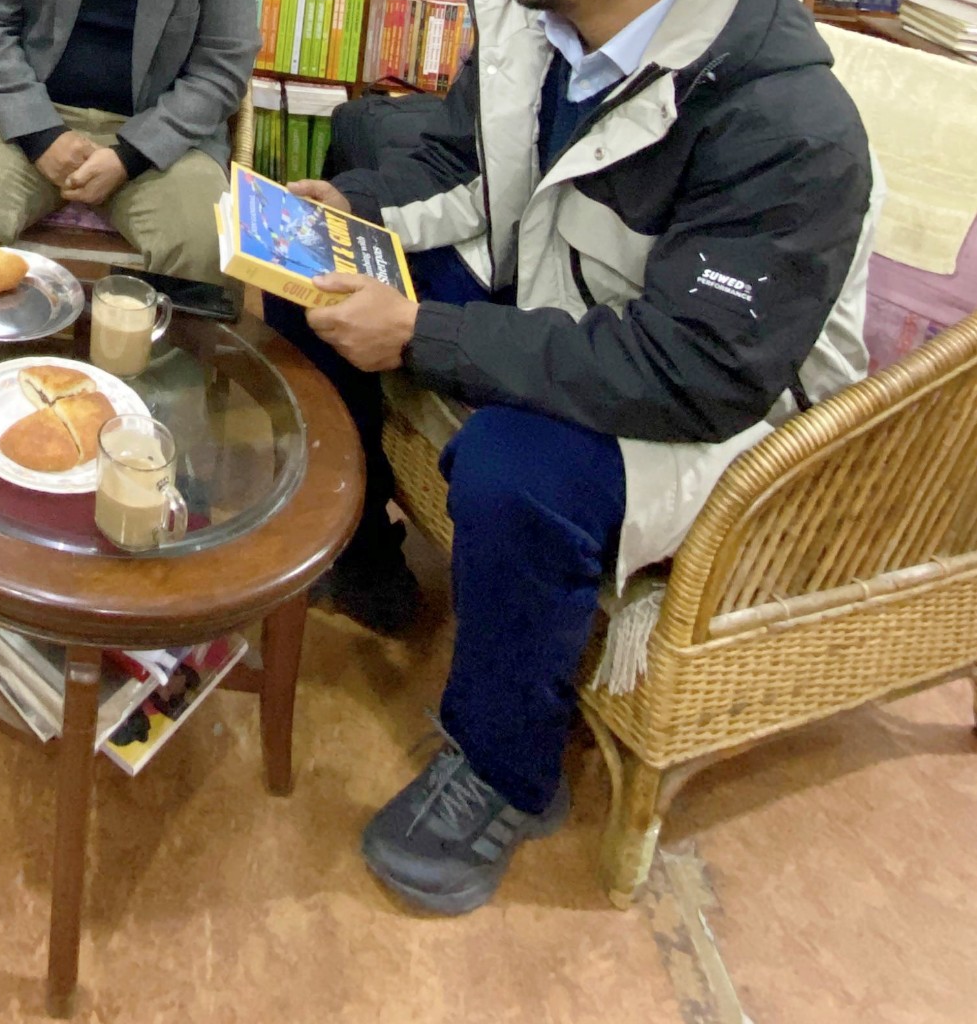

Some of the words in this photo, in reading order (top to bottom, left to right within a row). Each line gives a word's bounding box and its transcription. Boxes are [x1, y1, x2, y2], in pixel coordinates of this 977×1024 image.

[356, 235, 367, 251] with
[373, 245, 390, 286] Sherpas
[702, 269, 745, 290] SUWED
